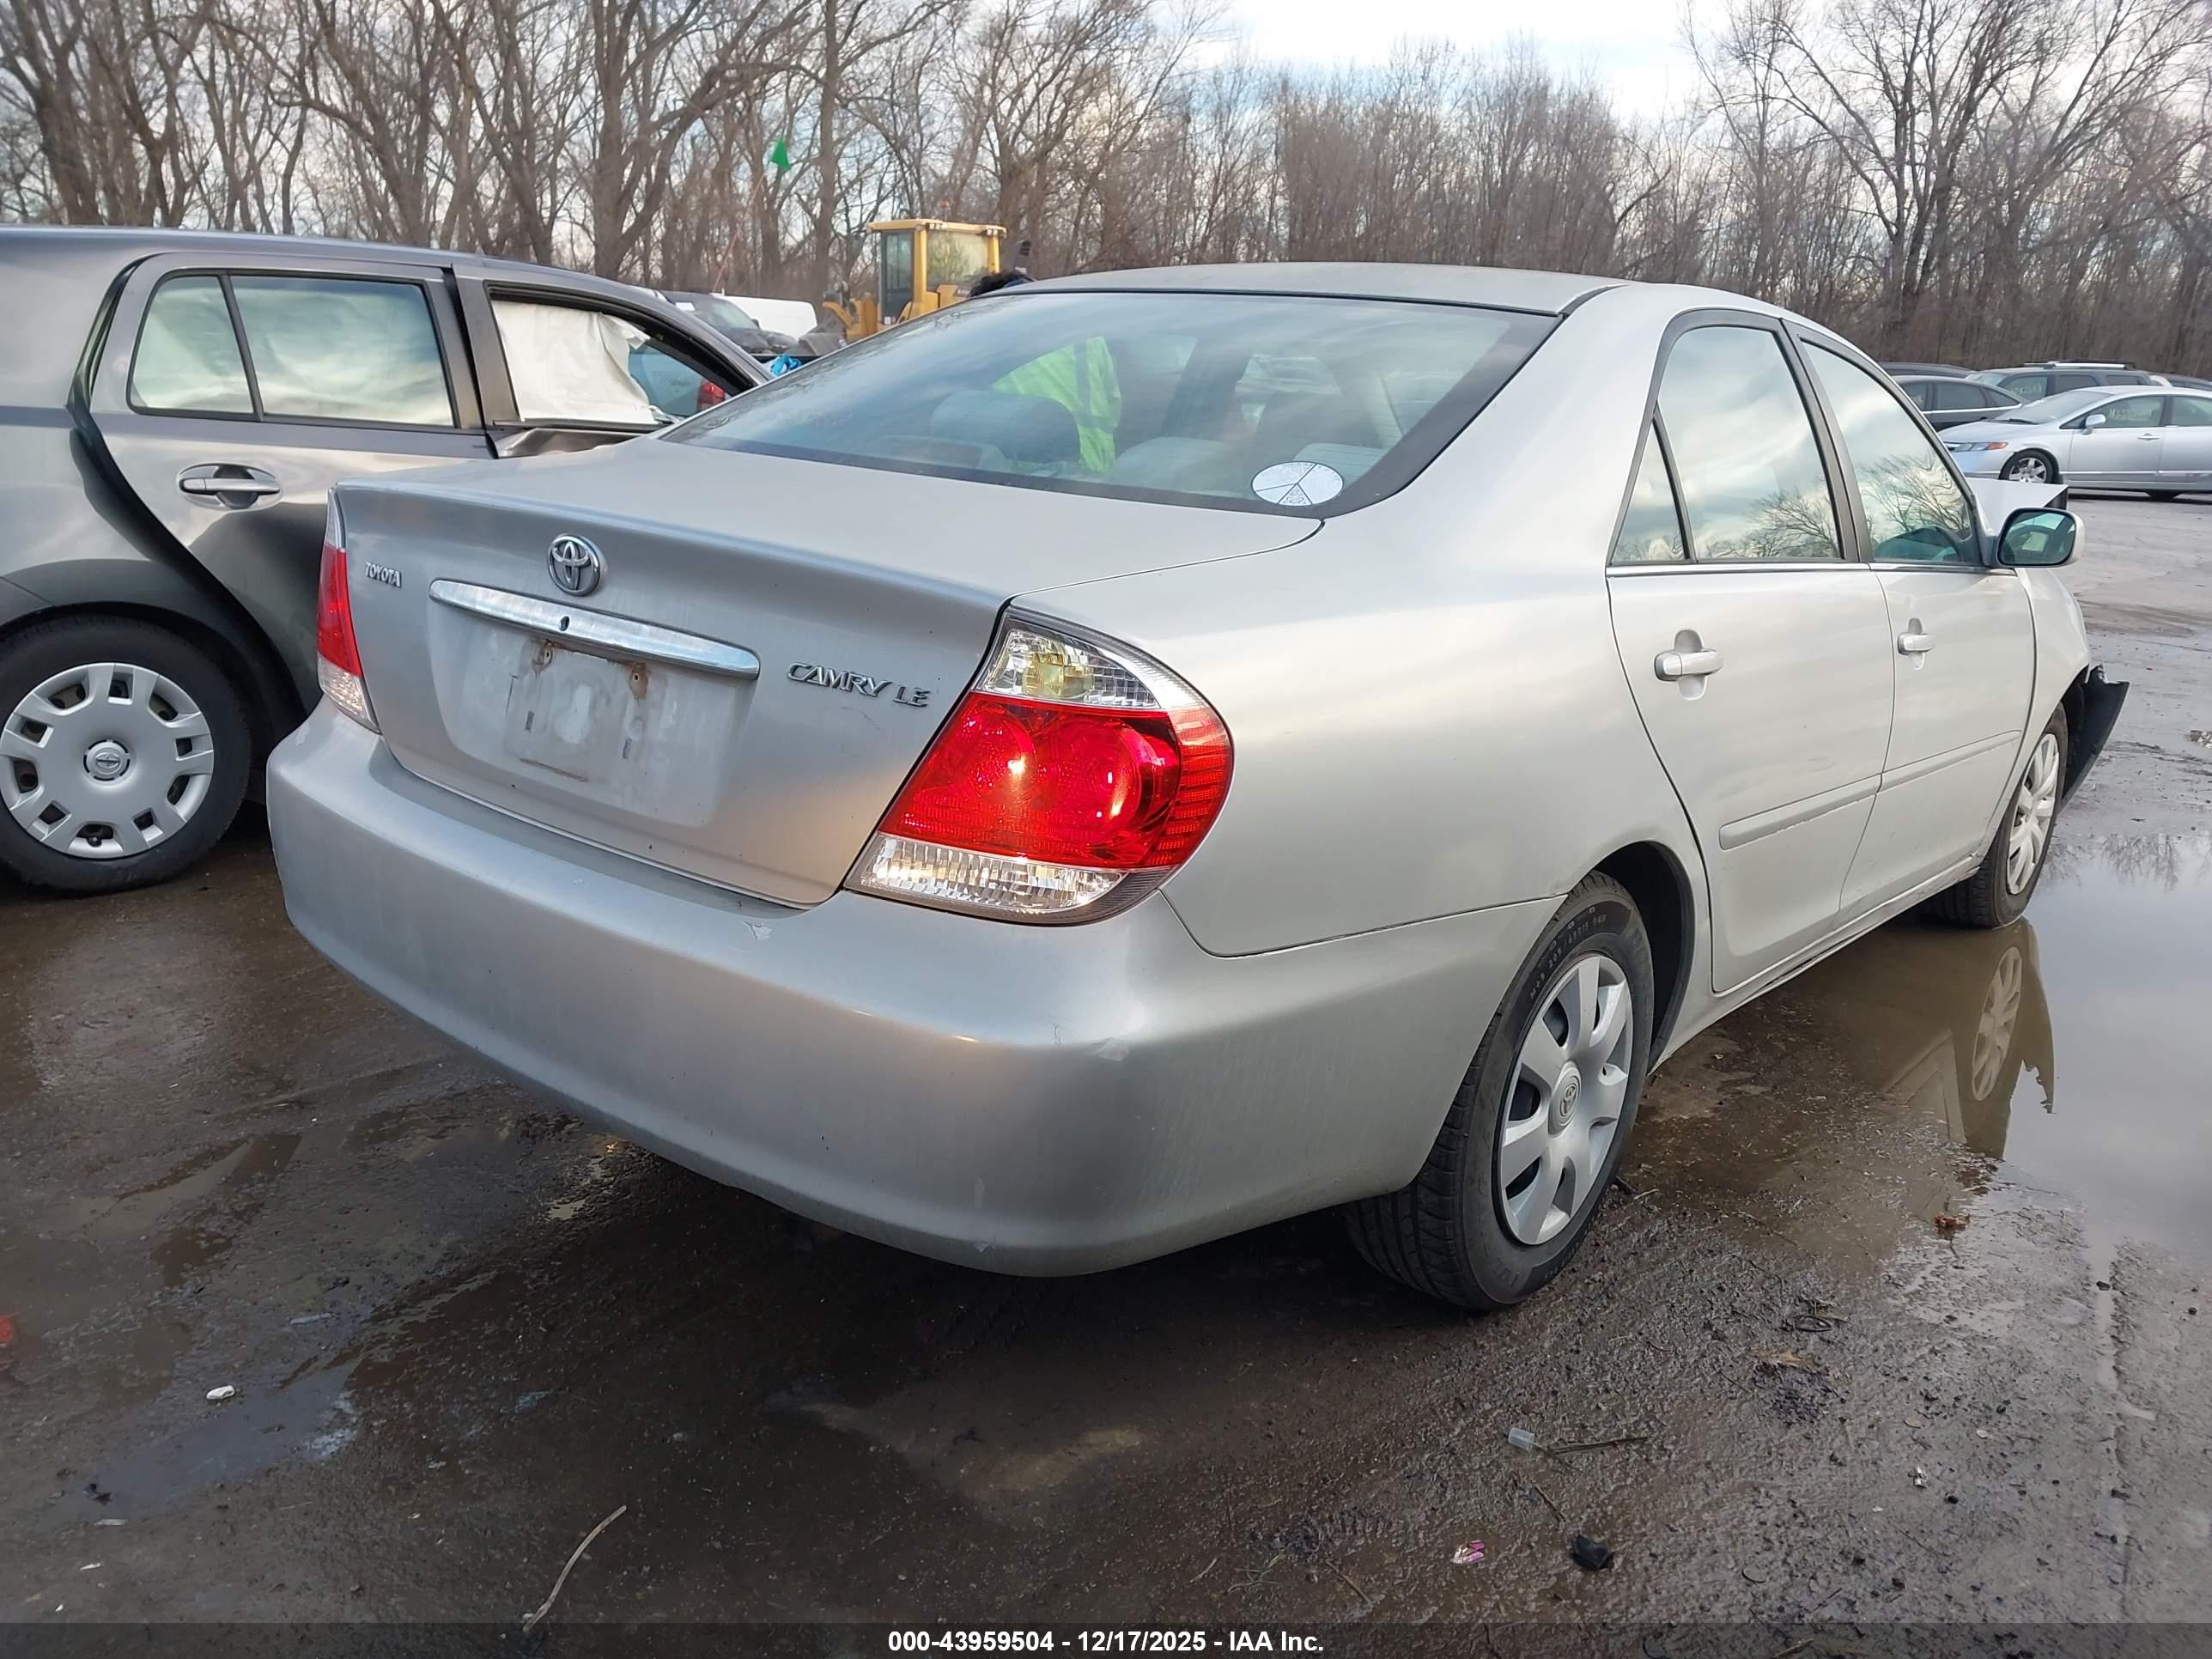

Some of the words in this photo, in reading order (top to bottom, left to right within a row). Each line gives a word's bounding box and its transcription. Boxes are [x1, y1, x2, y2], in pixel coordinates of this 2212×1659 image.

[365, 562, 402, 589] TOYOTA
[787, 662, 893, 698] CAMRY
[892, 686, 931, 708] LE
